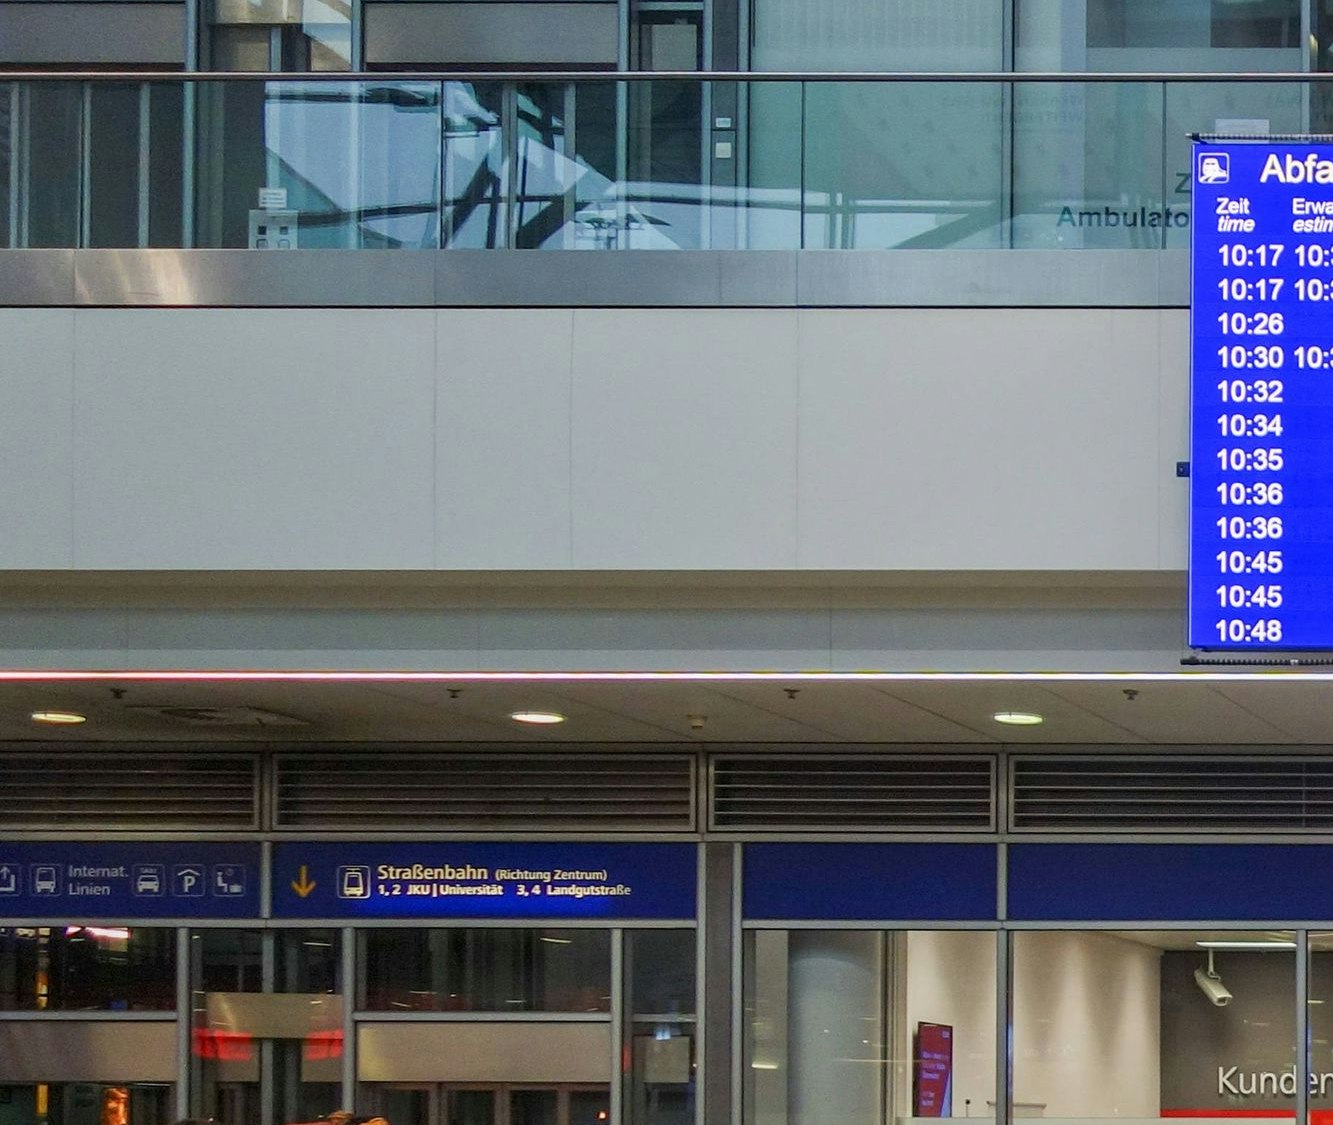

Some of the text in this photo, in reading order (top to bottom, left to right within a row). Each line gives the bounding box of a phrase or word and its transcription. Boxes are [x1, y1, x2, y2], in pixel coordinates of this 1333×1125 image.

[1216, 198, 1250, 216] Zeit
[1217, 216, 1256, 233] time
[1219, 245, 1284, 267] 10:17
[1219, 279, 1284, 301] 10:17
[1218, 313, 1284, 335] 10:26
[1218, 346, 1284, 369] 10:30
[68, 865, 129, 879] Internat.
[377, 865, 607, 883] Straßenbahn (Richtung Zentrum)
[68, 883, 111, 896] Linien
[392, 884, 401, 896] 2
[407, 884, 430, 896] JKU
[440, 883, 504, 896] Universität
[531, 884, 541, 896] 4
[547, 883, 632, 898] Landgutstraße
